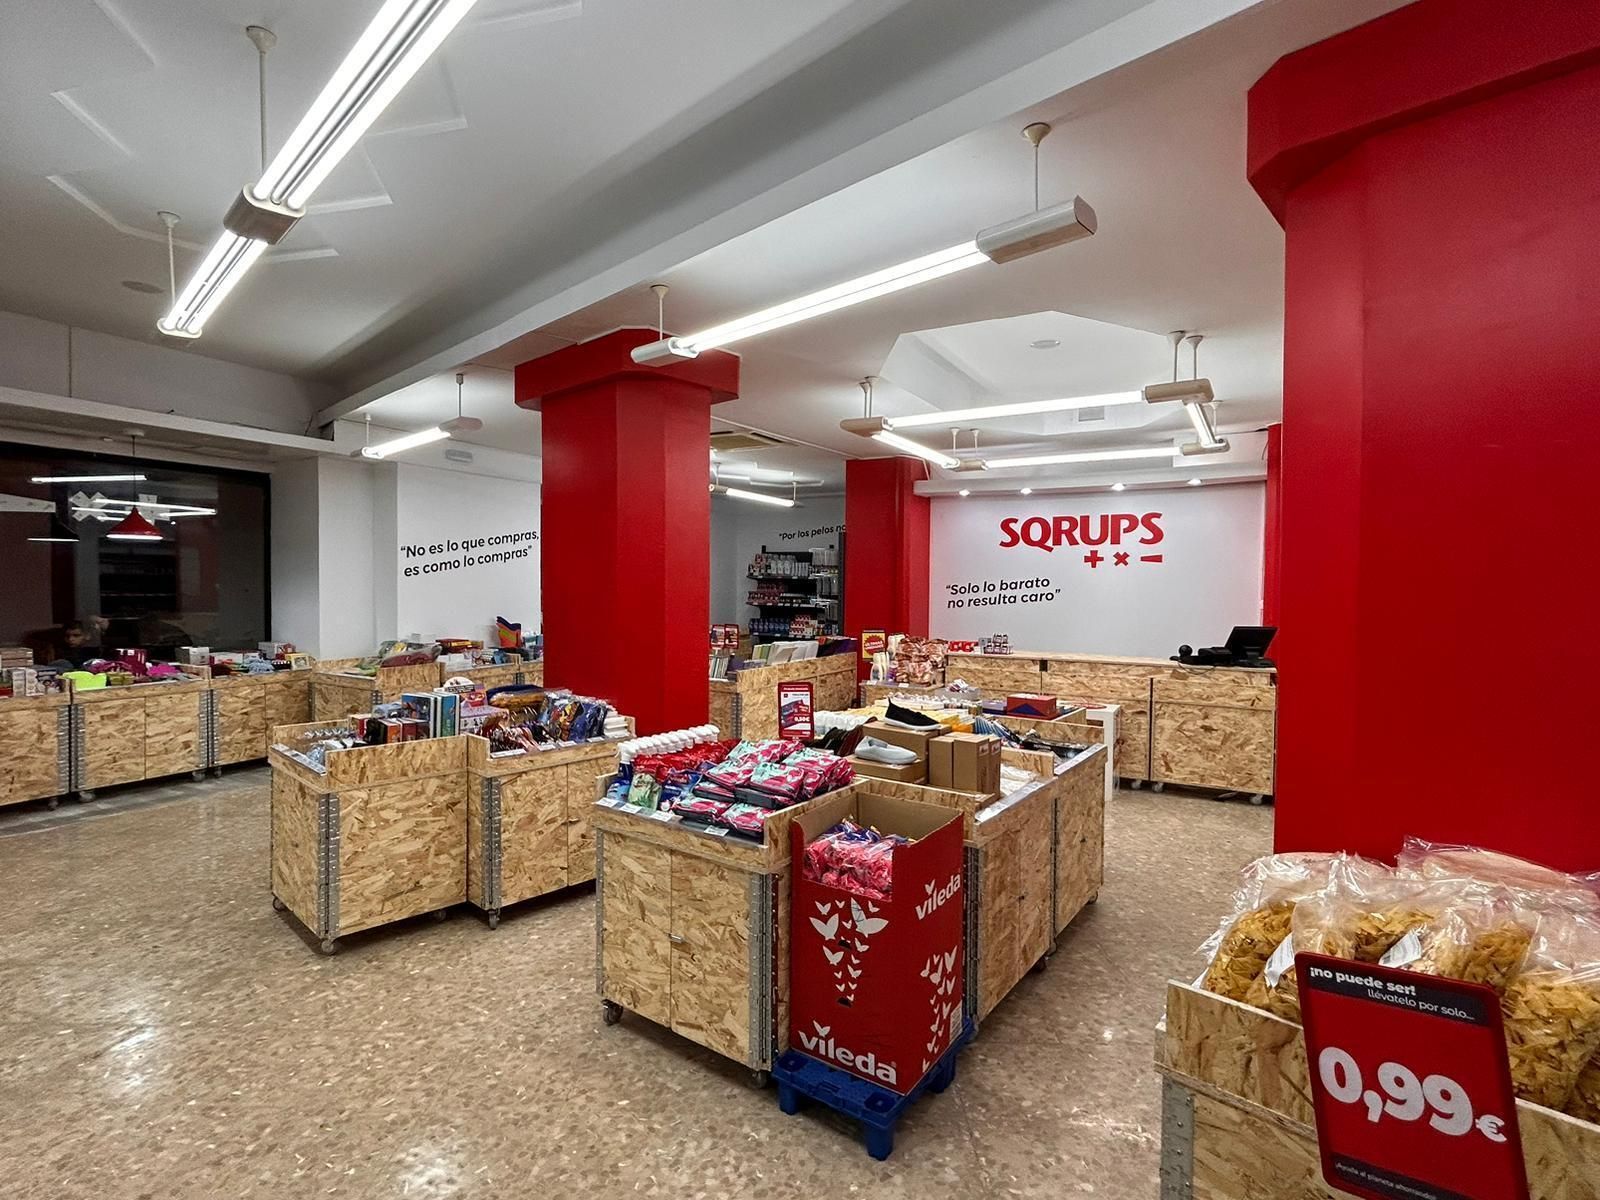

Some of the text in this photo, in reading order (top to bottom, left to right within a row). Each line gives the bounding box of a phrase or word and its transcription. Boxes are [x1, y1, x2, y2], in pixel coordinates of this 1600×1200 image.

[428, 543, 444, 554] es
[447, 540, 459, 552] lo
[461, 538, 485, 552] que
[487, 530, 539, 545] compras,
[797, 530, 809, 538] los
[811, 526, 834, 538] pelos
[999, 512, 1164, 552] SQRUPS
[404, 565, 420, 577] es
[422, 559, 461, 574] como
[463, 555, 475, 567] lo
[983, 581, 996, 592] lo
[1000, 577, 1050, 592] barato
[947, 598, 964, 609] no
[967, 593, 1017, 608] resulta
[915, 874, 962, 920] vileda
[1310, 967, 1416, 996] ¡no puede ser!
[1367, 988, 1417, 1007] llévatelo
[1418, 1001, 1439, 1012] por
[798, 1030, 897, 1085] vileda
[1318, 1046, 1508, 1143] 0,99€
